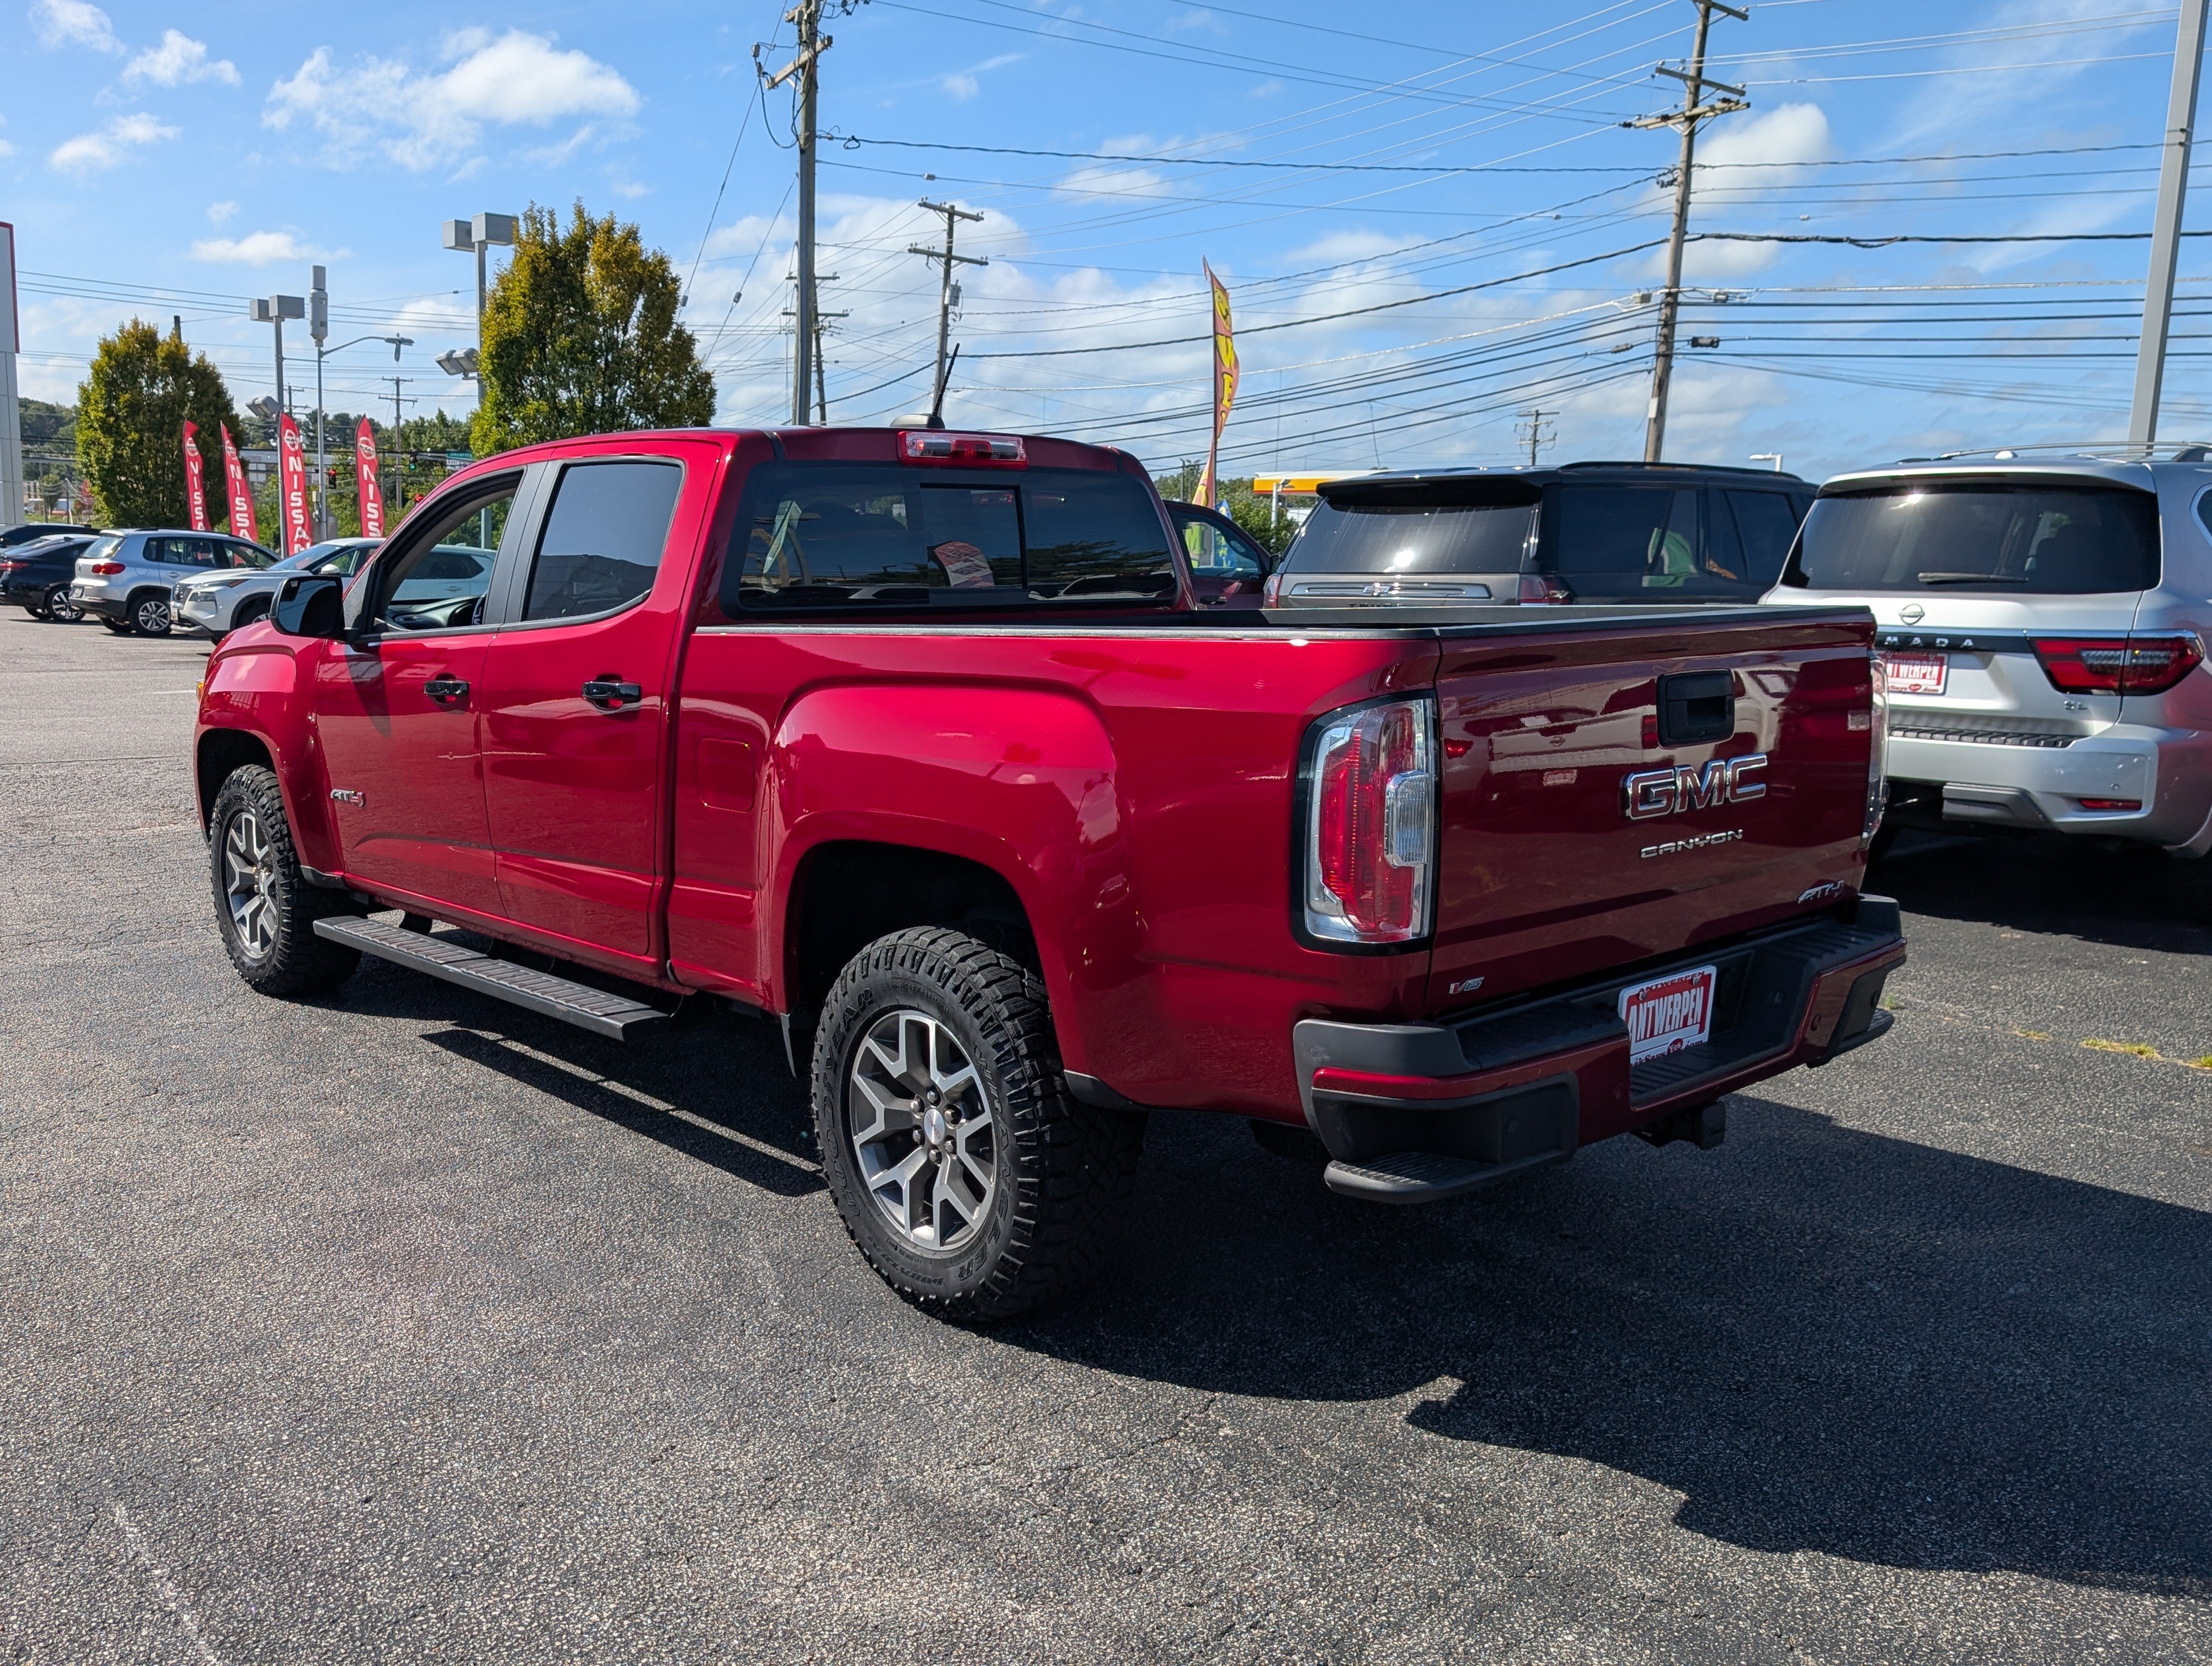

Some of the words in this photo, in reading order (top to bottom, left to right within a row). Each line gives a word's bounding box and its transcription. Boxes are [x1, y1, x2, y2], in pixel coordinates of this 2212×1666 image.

[190, 461, 204, 530] NISSA
[229, 464, 253, 542] NISSA
[362, 464, 383, 537] NISS
[1883, 636, 1974, 648] MADA
[1887, 659, 1939, 679] NTWERPEN
[330, 789, 364, 808] AT4
[1625, 753, 1767, 820] GMC
[1641, 829, 1743, 858] CANYON
[1449, 976, 1484, 994] V6
[1628, 986, 1703, 1042] ANTWERPEN
[823, 987, 875, 1217] GOODYEAR
